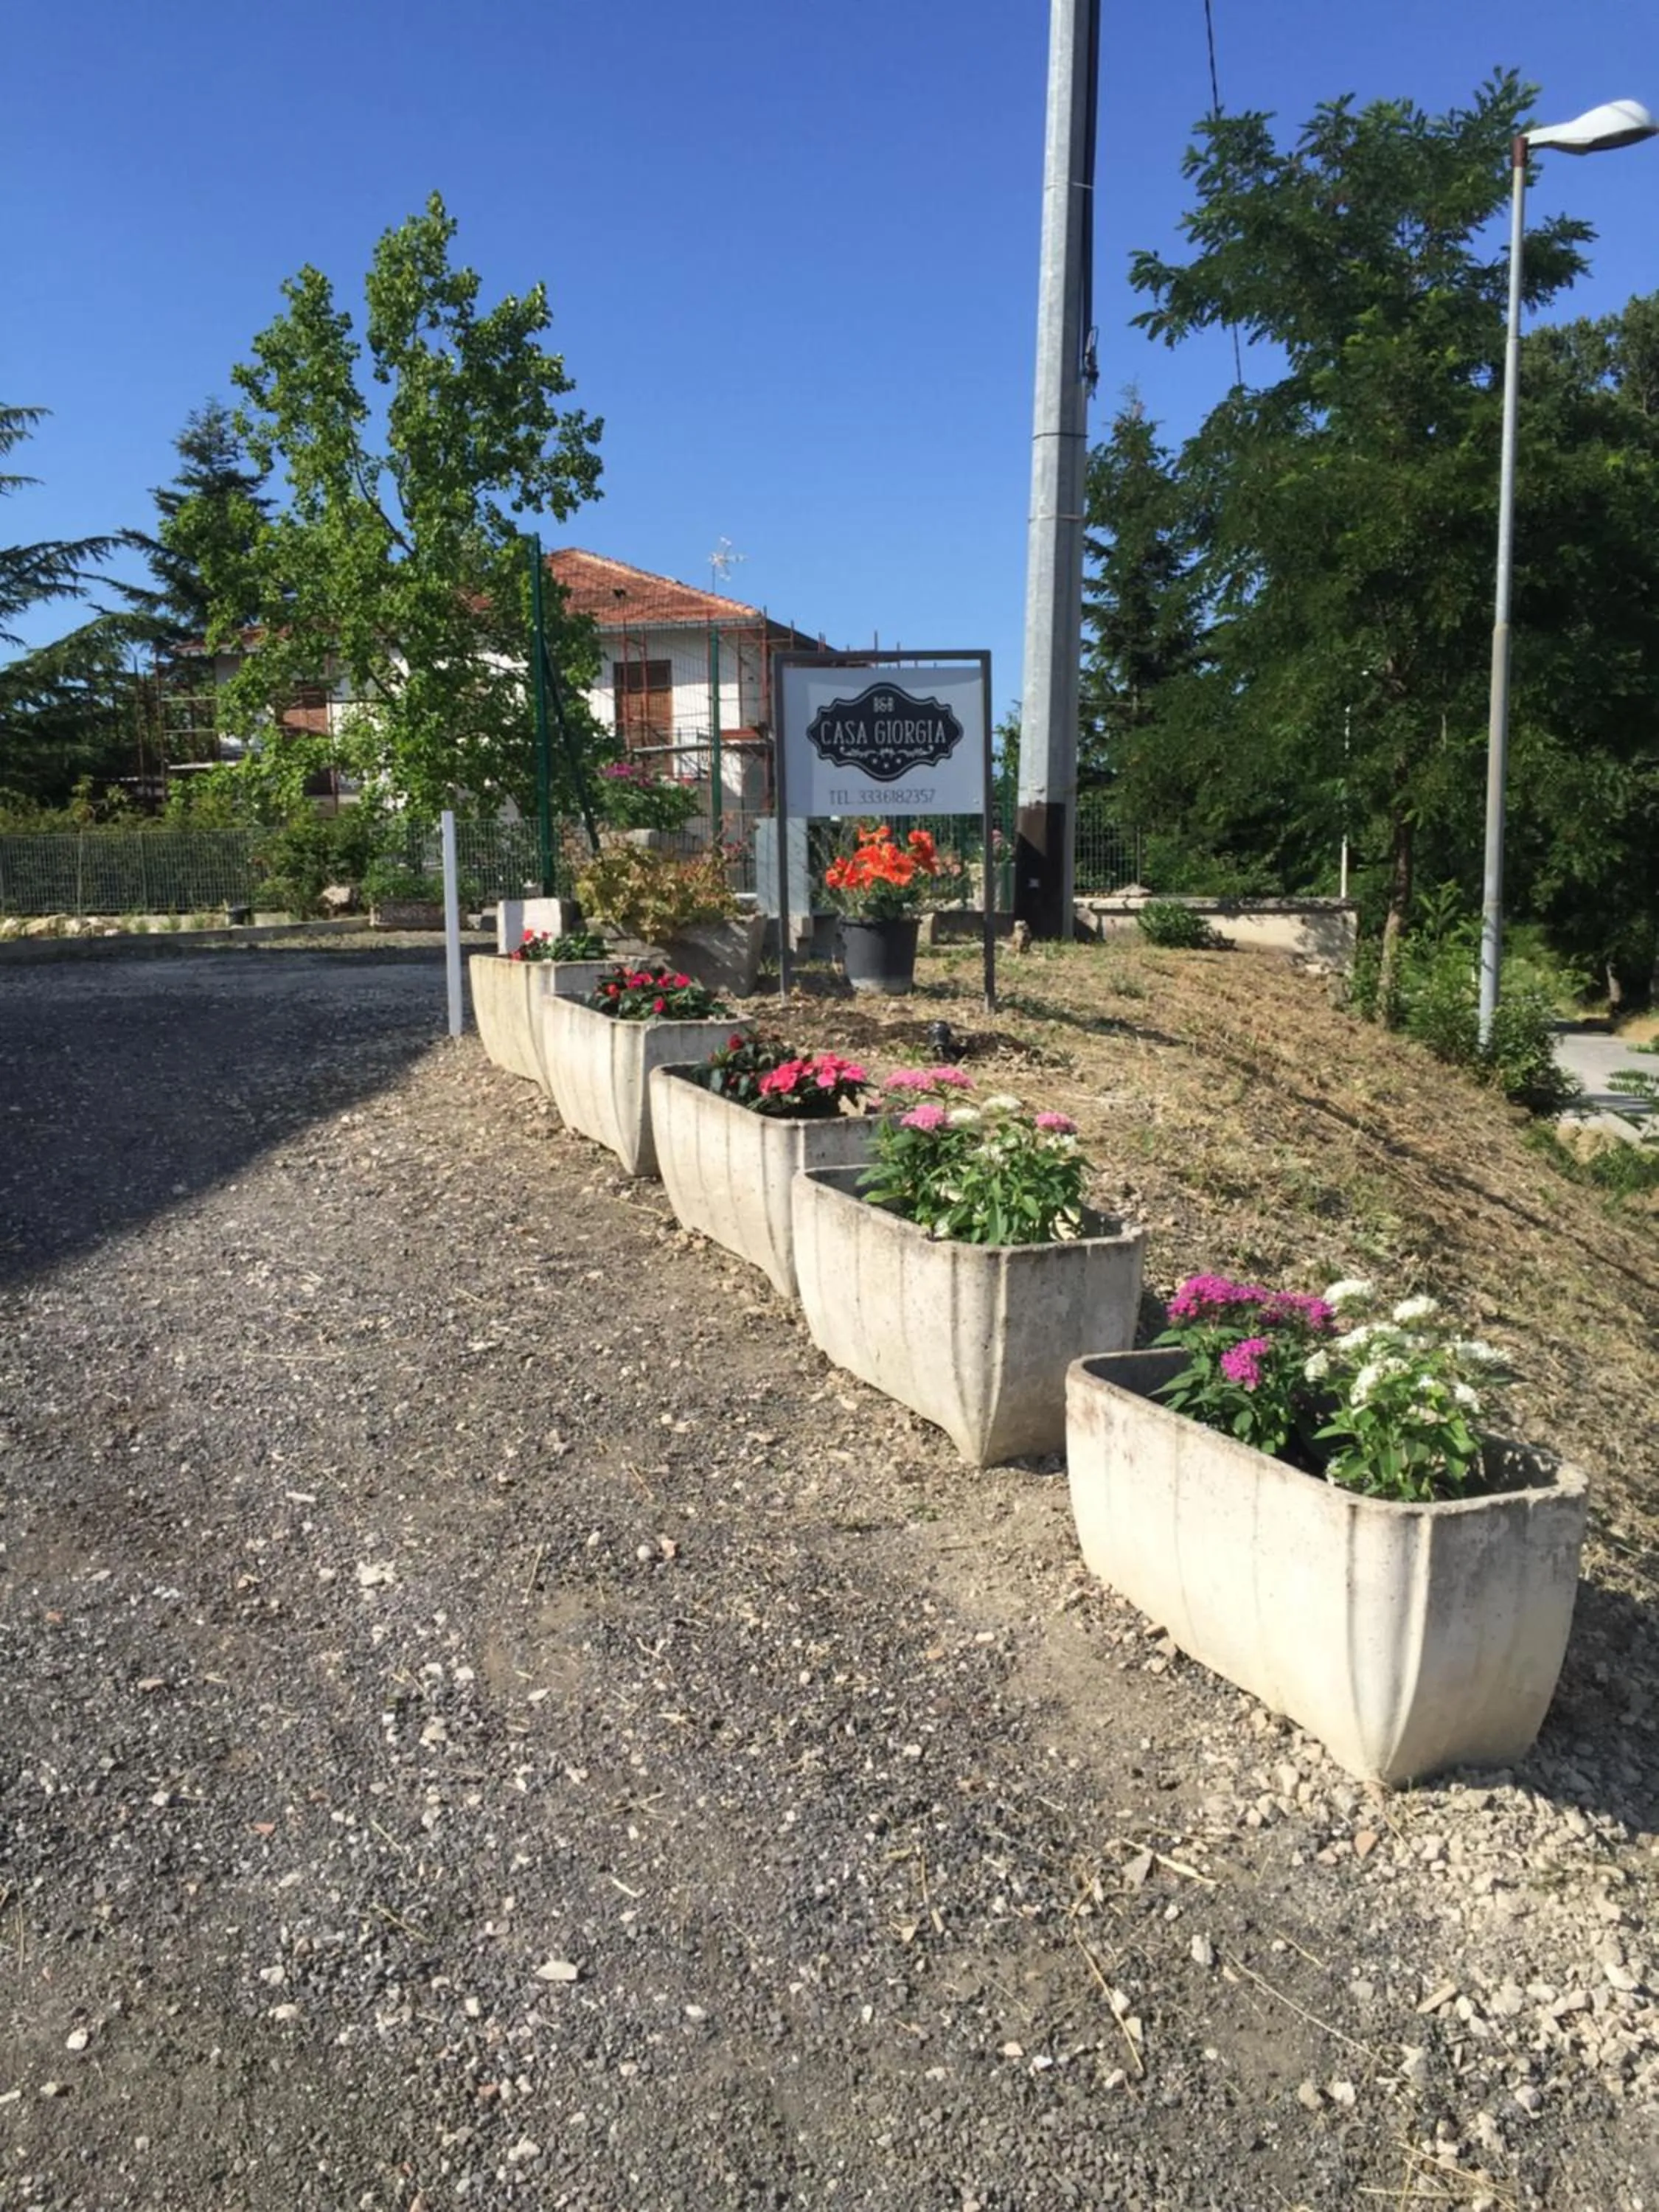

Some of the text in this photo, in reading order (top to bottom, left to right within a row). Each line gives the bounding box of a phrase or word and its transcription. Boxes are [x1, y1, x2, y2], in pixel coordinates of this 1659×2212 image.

[820, 720, 946, 745] CASA GIORGIA
[858, 788, 936, 804] 3336182357
